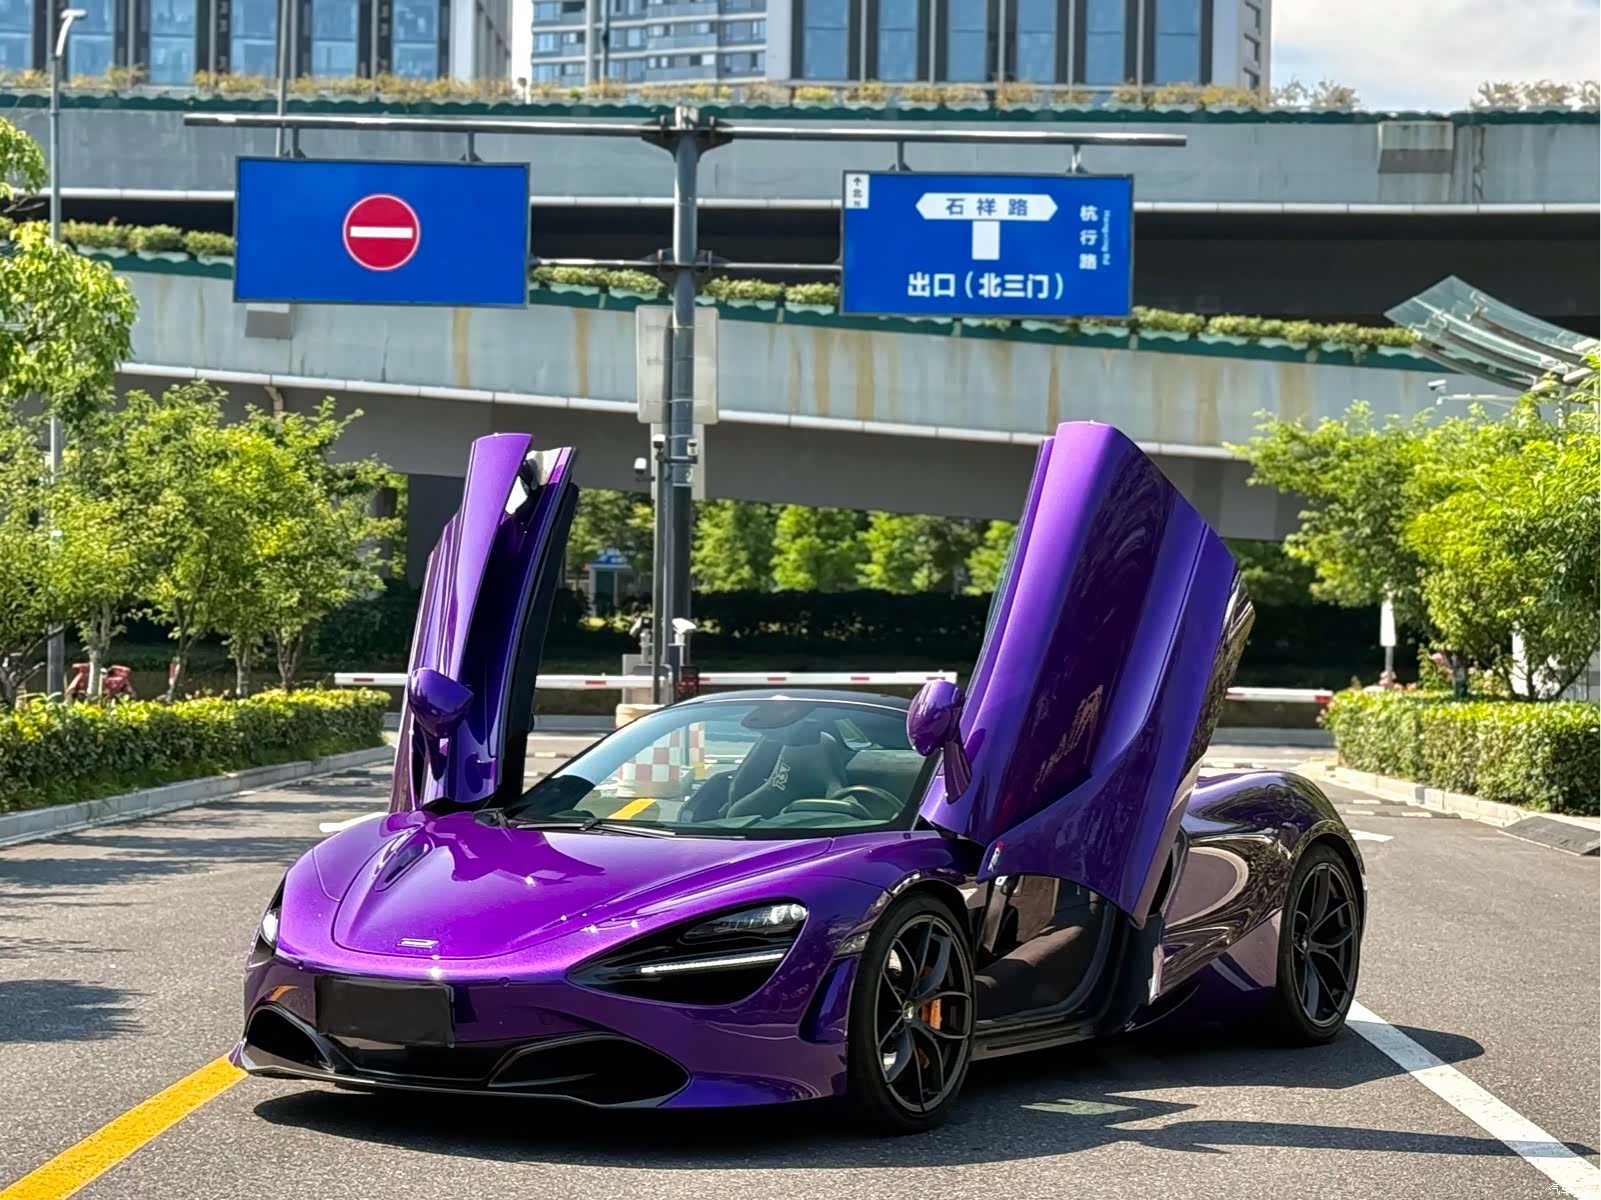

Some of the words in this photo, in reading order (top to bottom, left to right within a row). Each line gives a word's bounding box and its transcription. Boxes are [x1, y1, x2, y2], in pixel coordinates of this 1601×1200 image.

[852, 188, 863, 199] 北
[945, 197, 1028, 217] 石祥路
[1079, 204, 1099, 270] 杭行路
